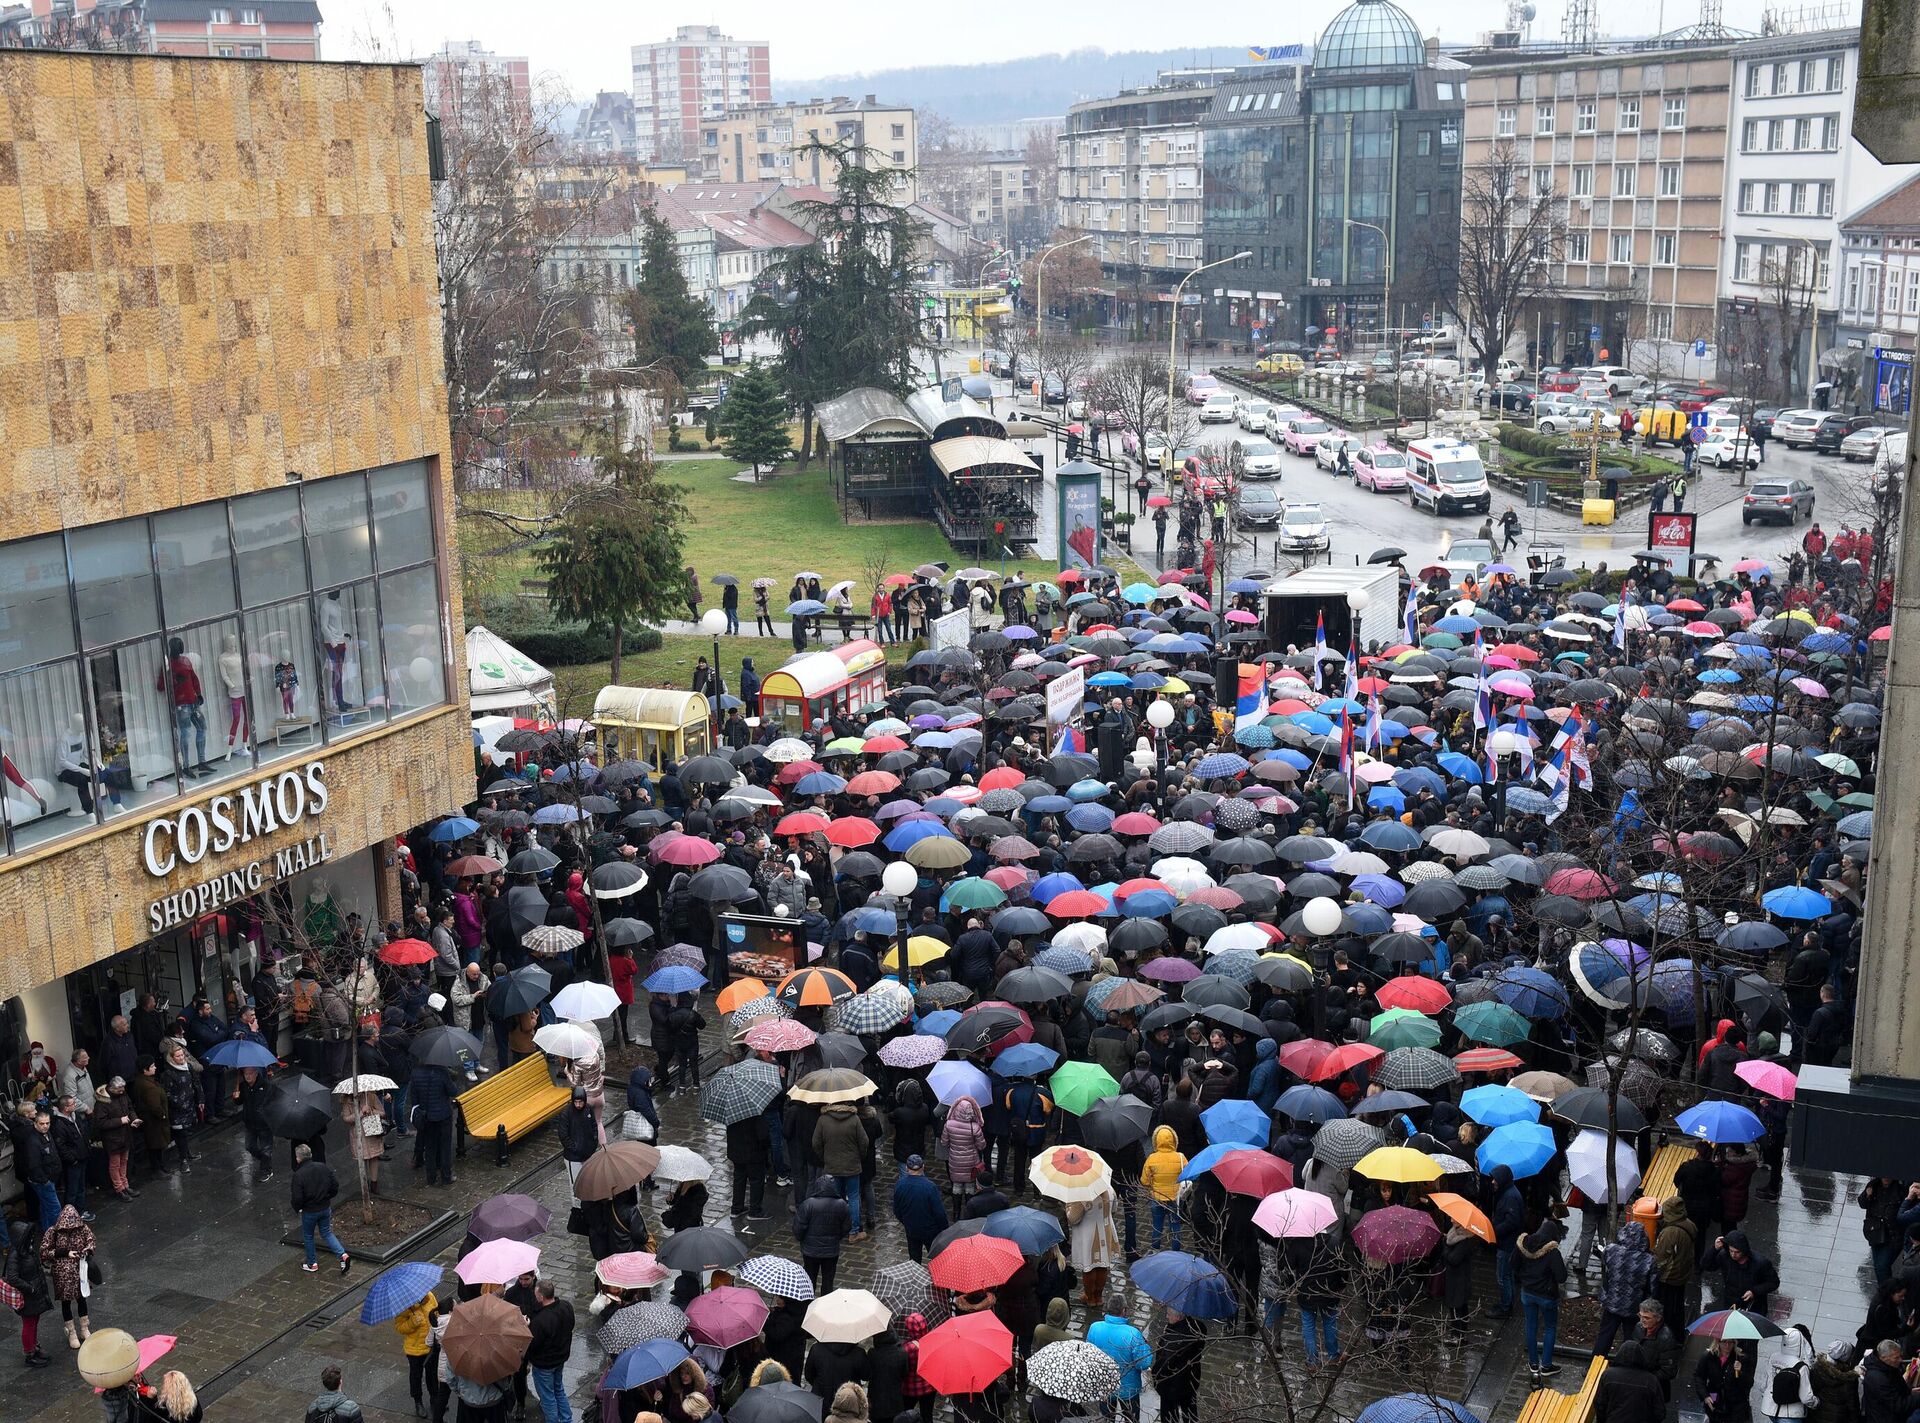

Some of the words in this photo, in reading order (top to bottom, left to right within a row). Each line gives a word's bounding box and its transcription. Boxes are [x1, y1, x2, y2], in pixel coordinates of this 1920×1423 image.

[1268, 44, 1303, 60] ПОШТА
[144, 761, 329, 878] COSMOS
[149, 861, 263, 934] SHOPPING
[275, 833, 333, 881] MALL
